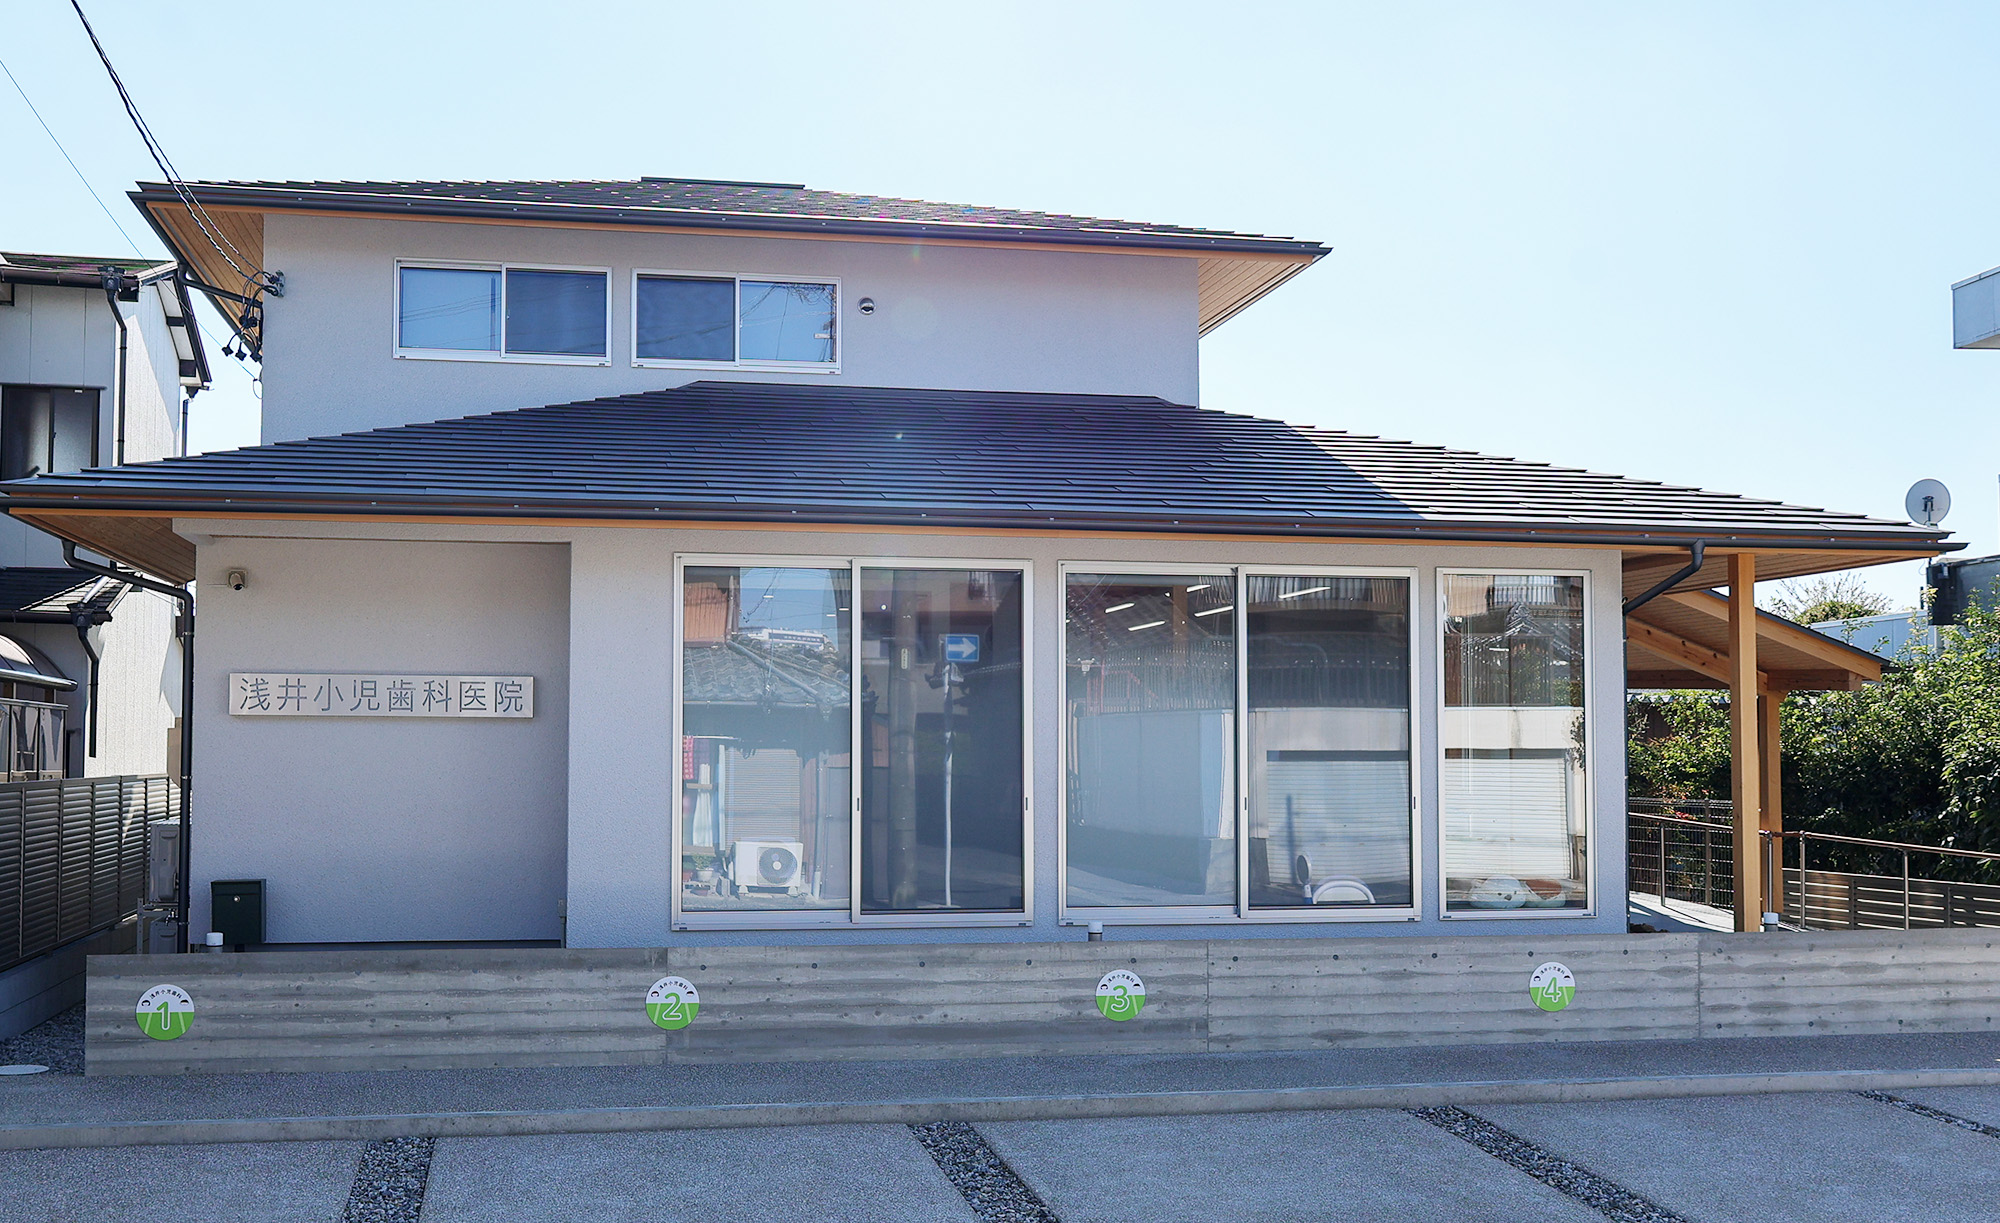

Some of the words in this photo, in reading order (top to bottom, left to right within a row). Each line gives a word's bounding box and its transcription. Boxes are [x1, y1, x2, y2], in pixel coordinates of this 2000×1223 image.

[239, 677, 523, 713] 浅井小児歯科医院
[1111, 985, 1130, 1012] 3
[1543, 977, 1562, 1002] 4
[156, 1001, 171, 1030] 1
[662, 992, 682, 1020] 2
